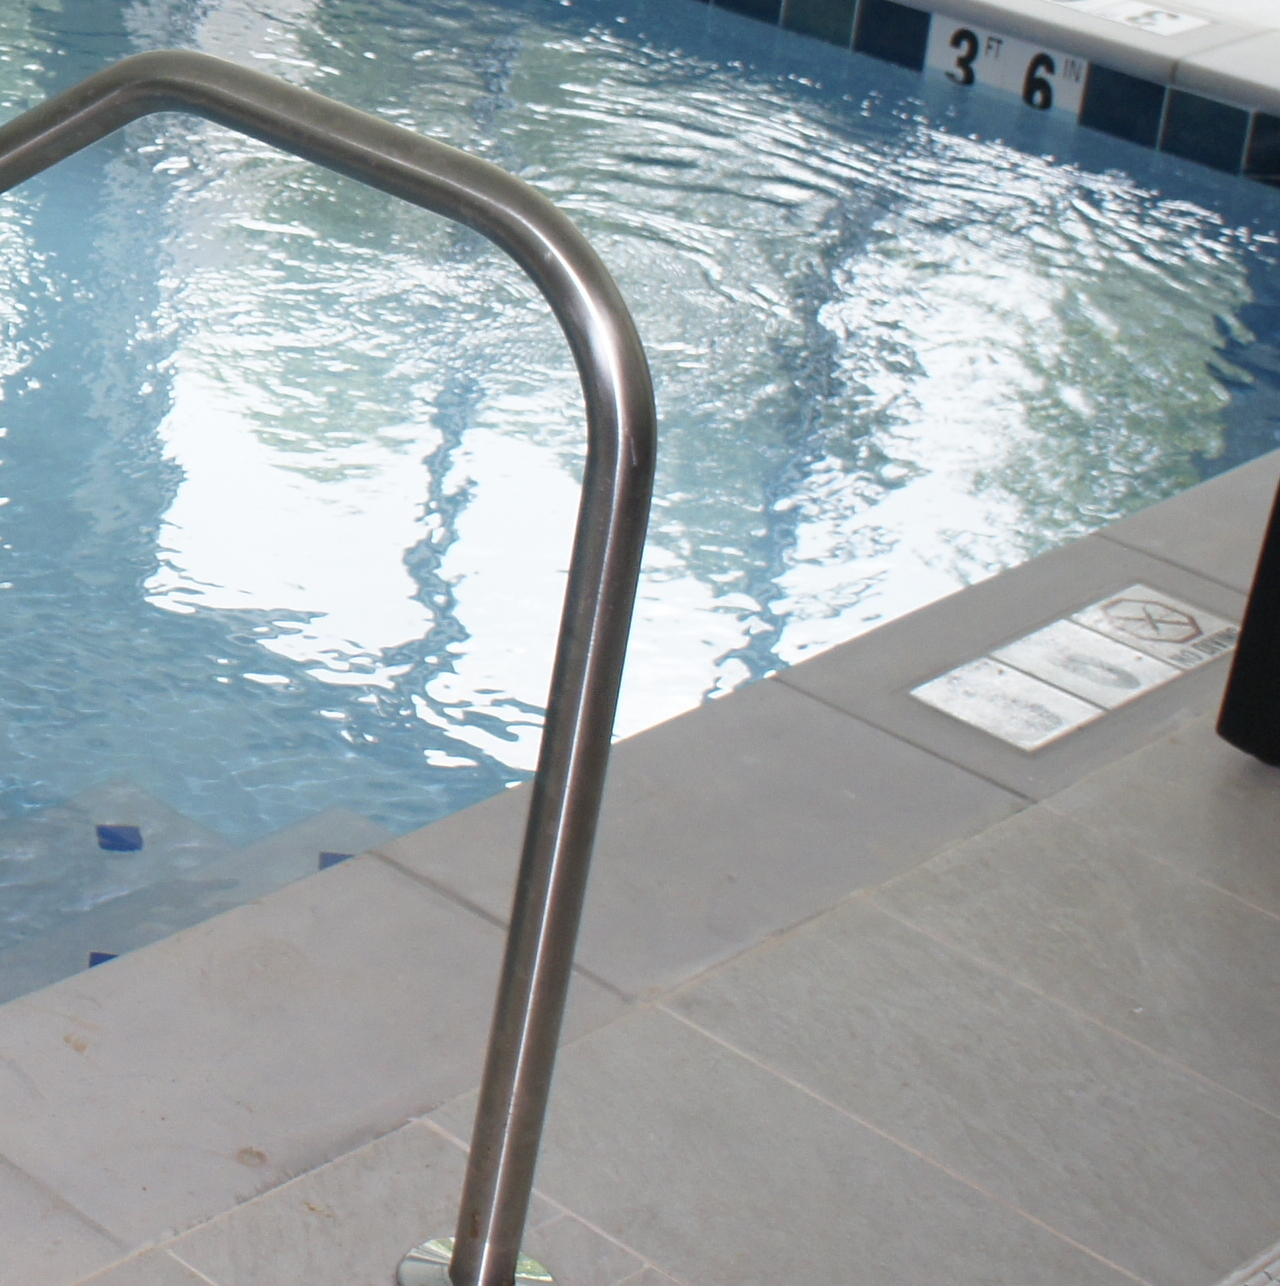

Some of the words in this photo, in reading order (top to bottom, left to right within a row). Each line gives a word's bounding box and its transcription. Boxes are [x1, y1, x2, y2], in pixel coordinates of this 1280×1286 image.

[944, 28, 979, 86] 3
[984, 36, 1003, 61] FT
[1022, 52, 1055, 110] 6
[1063, 58, 1081, 83] IN
